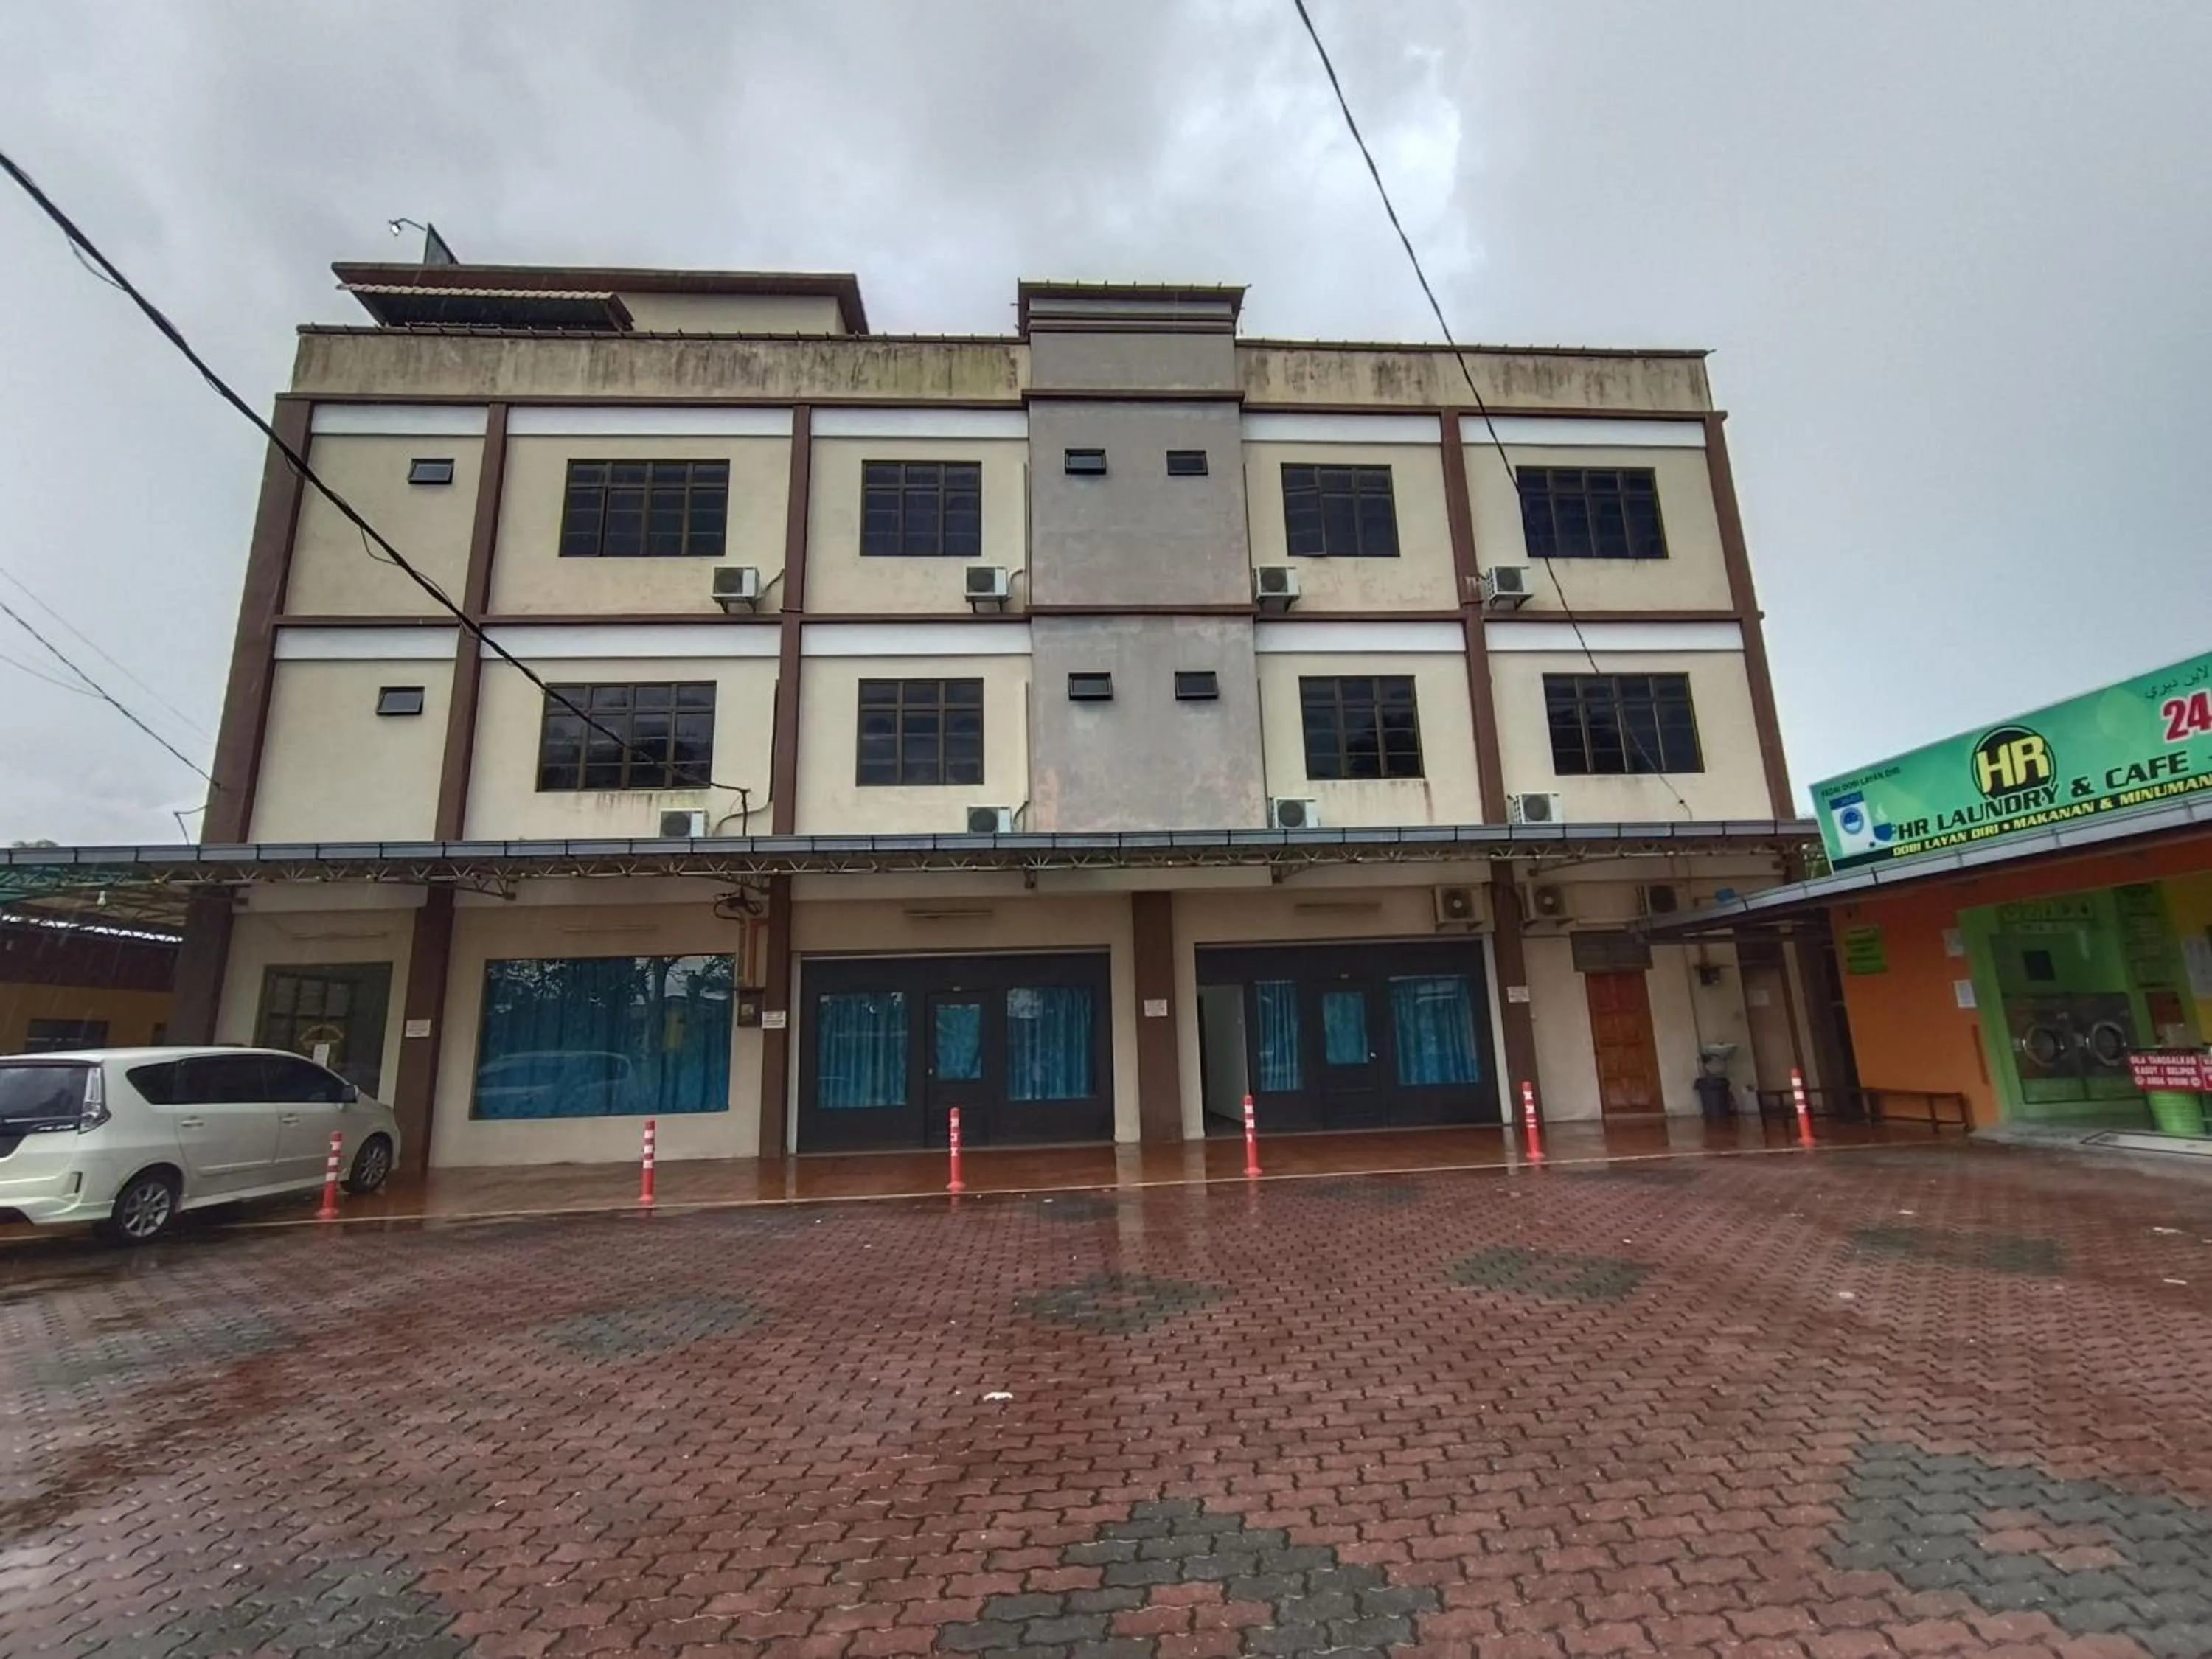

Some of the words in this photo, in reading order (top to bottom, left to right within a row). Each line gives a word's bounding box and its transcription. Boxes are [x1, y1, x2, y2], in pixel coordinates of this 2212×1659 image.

[2162, 691, 2212, 741] 24
[1898, 818, 1929, 840] HR
[1937, 784, 2059, 831] LAUNDRY
[2070, 776, 2095, 798] &
[2105, 751, 2189, 790] CAFE
[1977, 735, 2050, 793] HR
[1892, 843, 1921, 857] DOBI
[1925, 831, 1968, 850] LAYAN
[1971, 824, 1999, 840] DIRI
[2013, 801, 2096, 830] MAKANAN
[2099, 795, 2113, 810] &
[2118, 773, 2212, 806] MINUMAN
